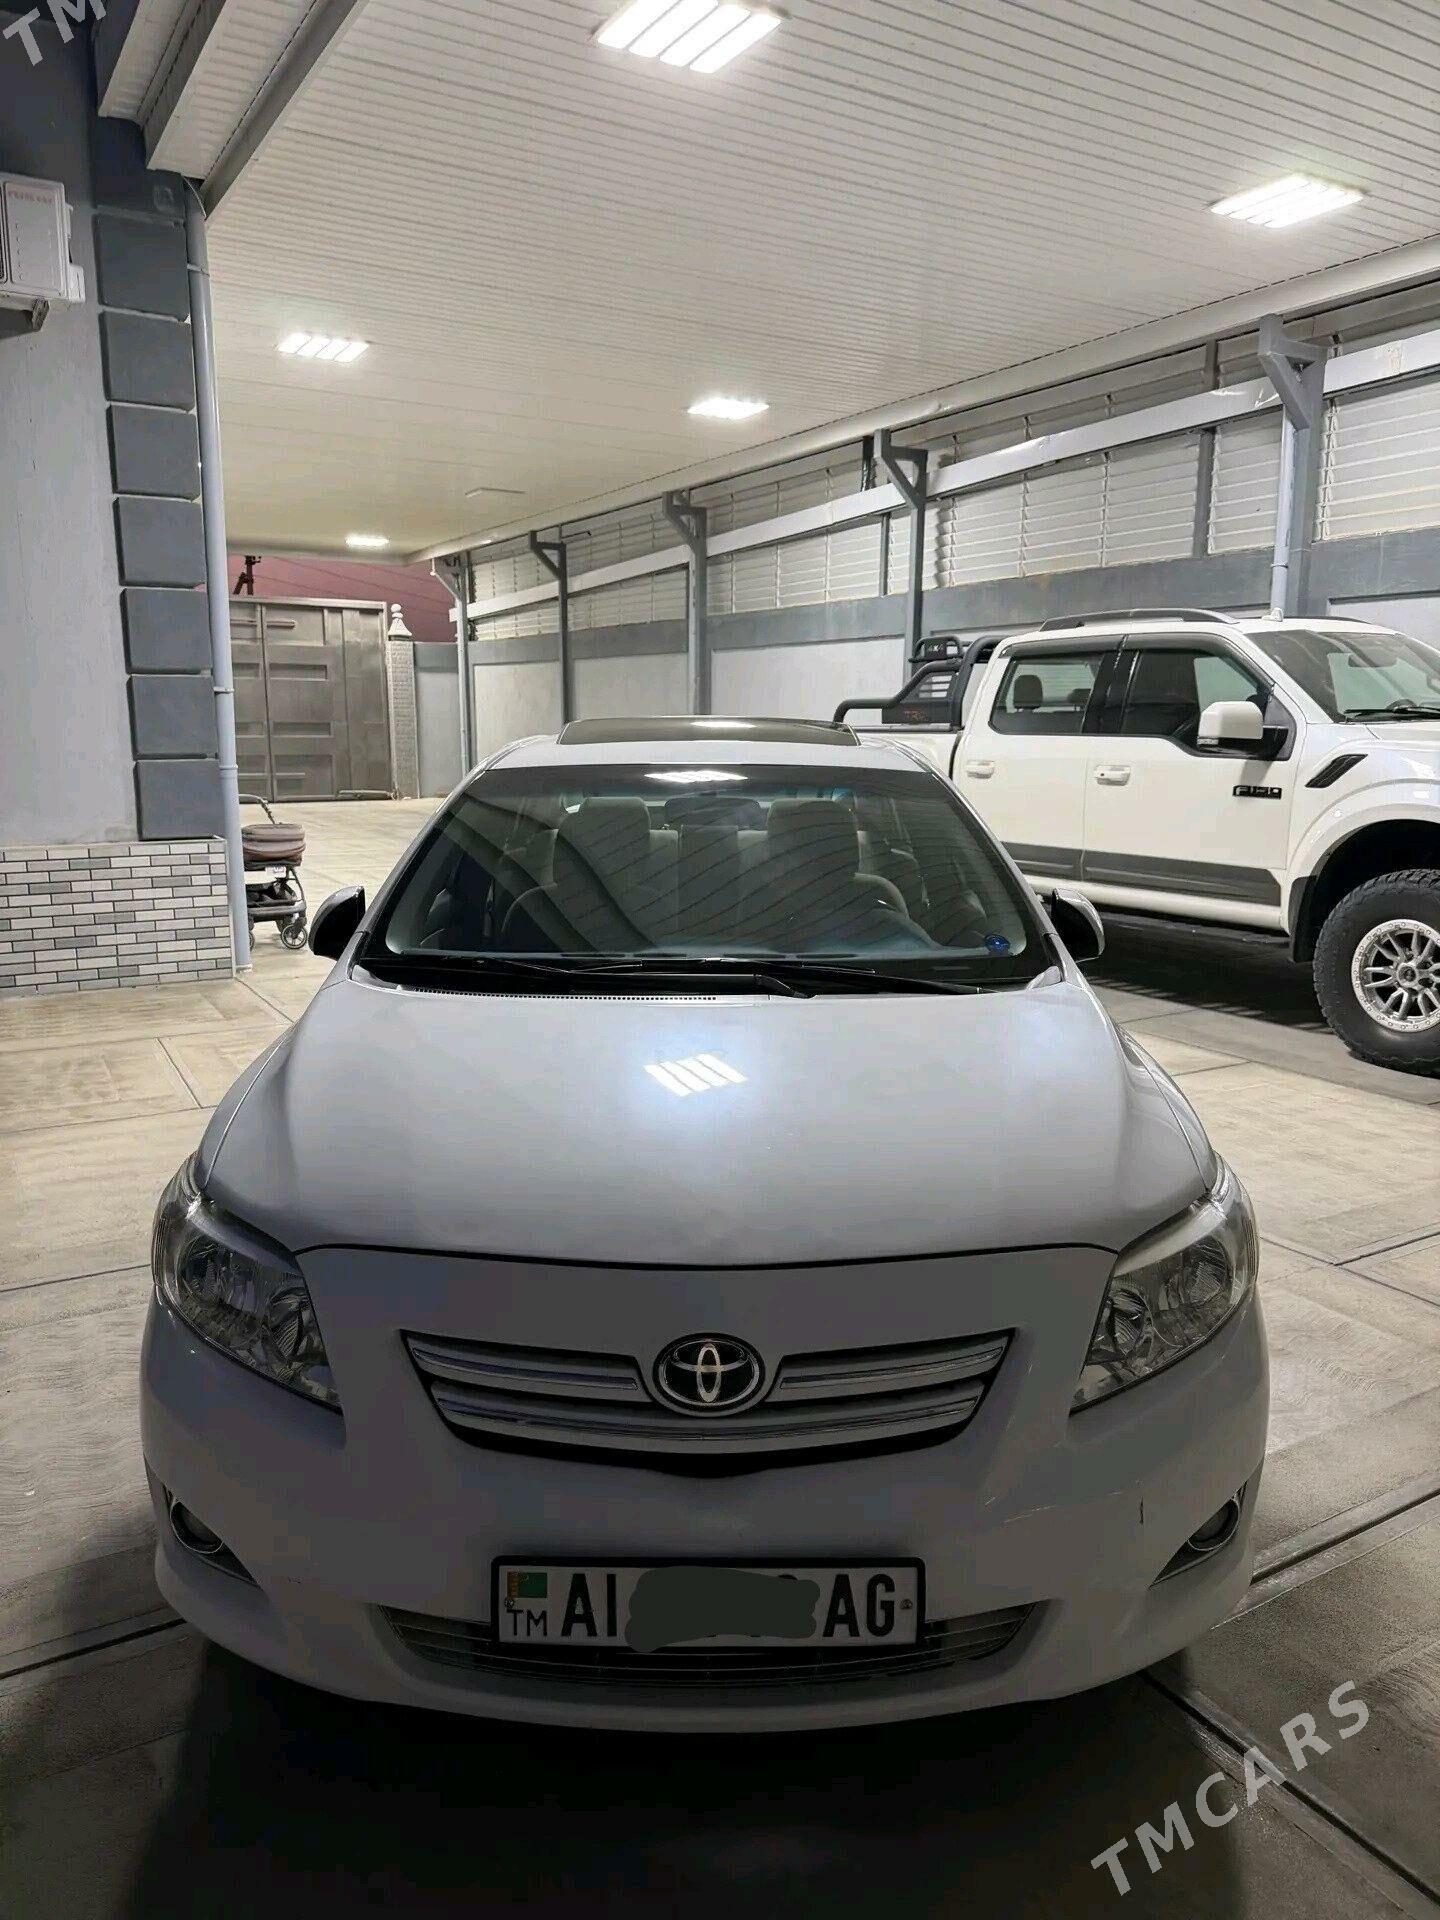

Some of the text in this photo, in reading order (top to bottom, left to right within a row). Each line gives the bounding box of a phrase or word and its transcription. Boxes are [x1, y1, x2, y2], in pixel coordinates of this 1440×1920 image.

[506, 1609, 547, 1637] TM
[560, 1573, 617, 1638] AI
[823, 1573, 896, 1638] AG
